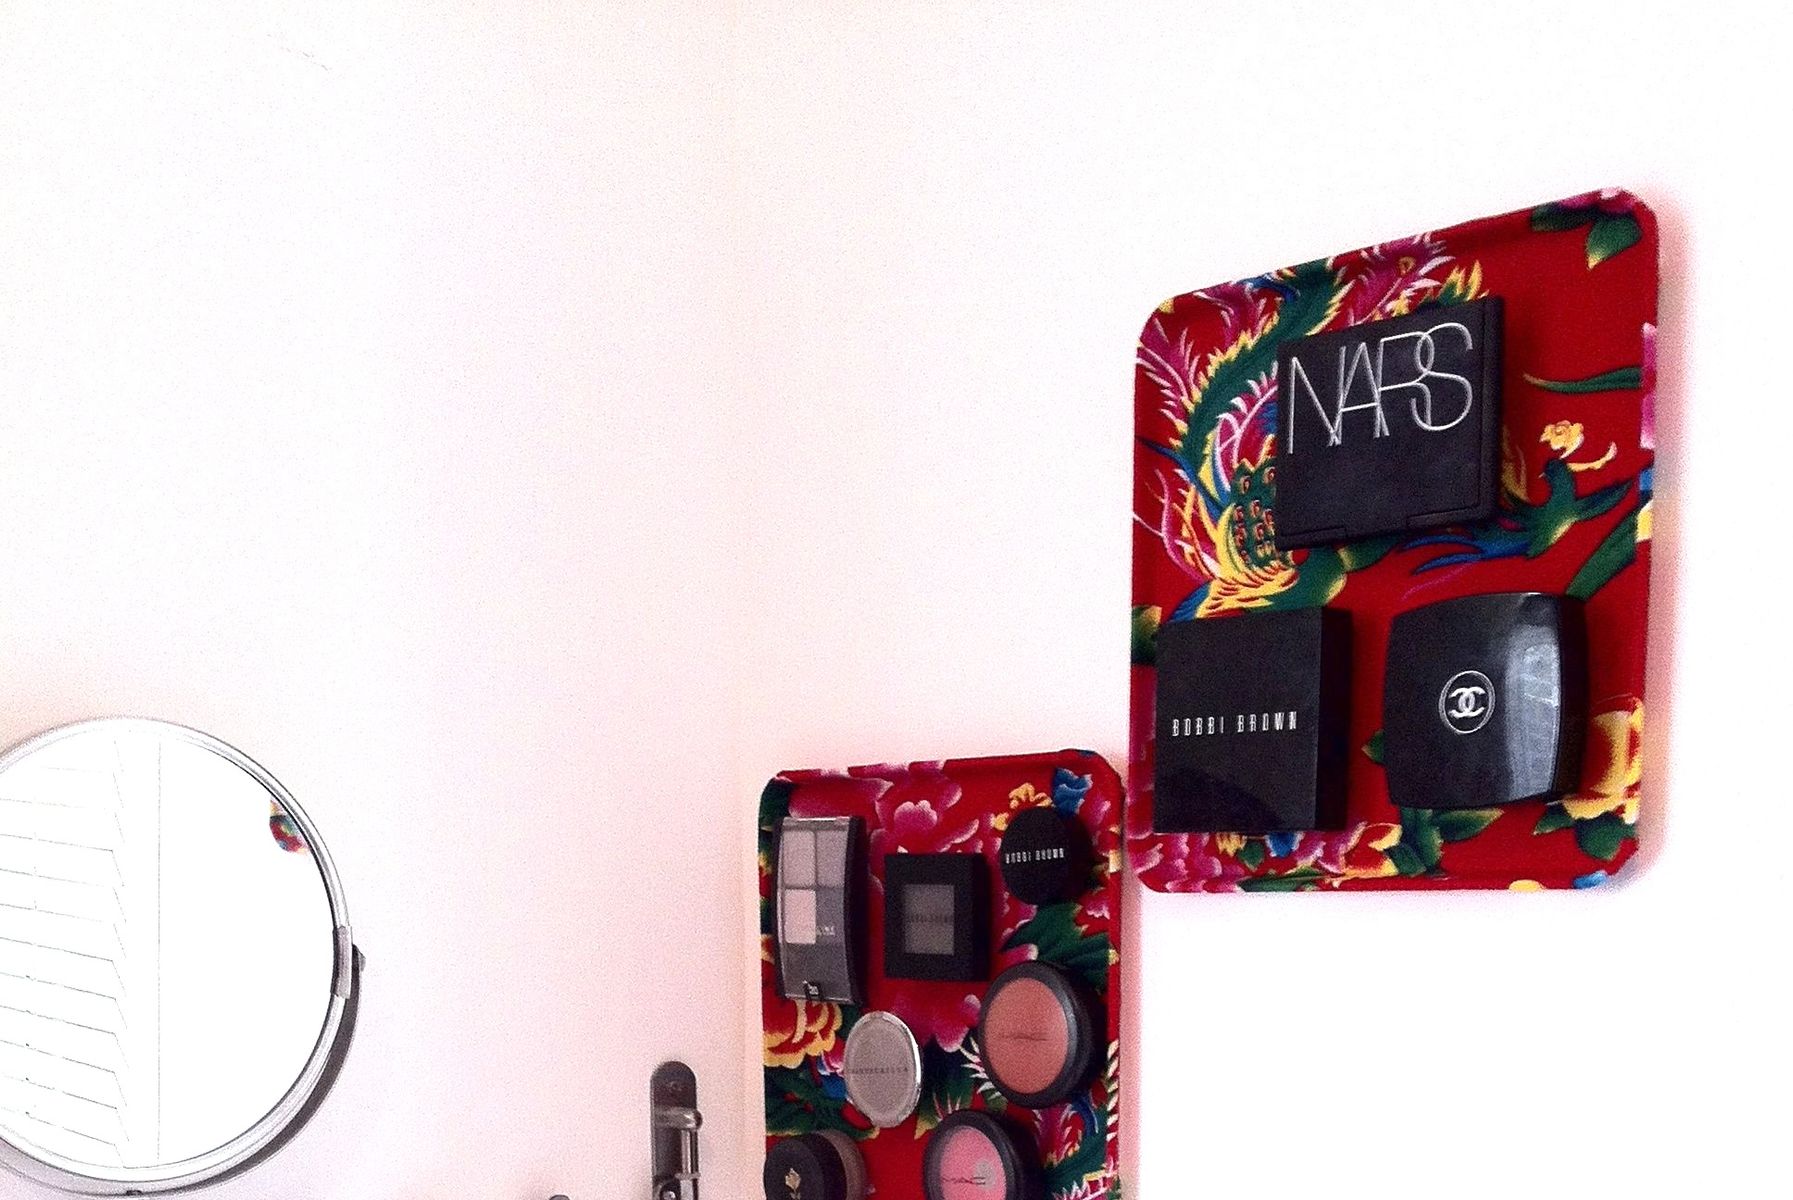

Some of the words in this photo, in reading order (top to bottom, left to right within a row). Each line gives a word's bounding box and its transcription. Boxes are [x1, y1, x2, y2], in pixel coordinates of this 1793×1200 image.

[1288, 322, 1473, 454] NARS
[1171, 716, 1224, 737] BOBBI
[1237, 711, 1297, 732] BROWN
